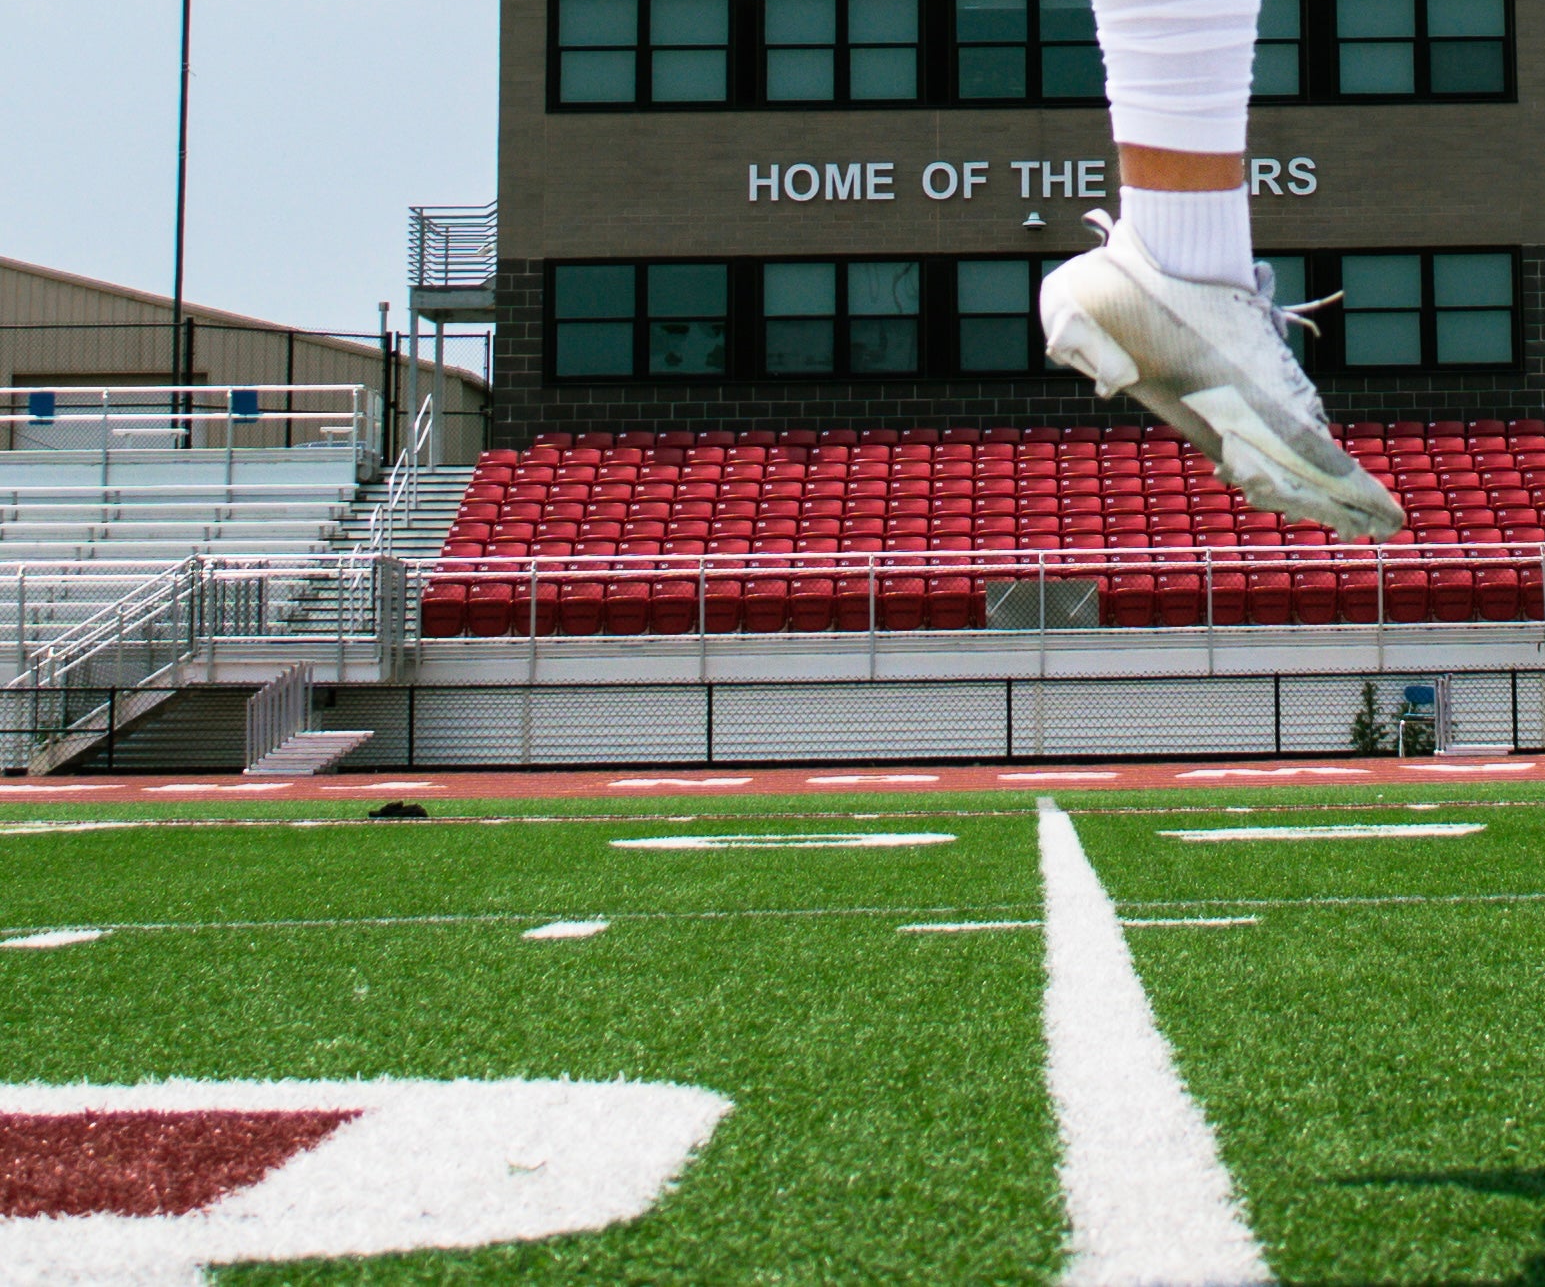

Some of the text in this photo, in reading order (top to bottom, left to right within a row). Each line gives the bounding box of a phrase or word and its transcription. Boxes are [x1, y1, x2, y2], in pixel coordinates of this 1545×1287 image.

[748, 163, 895, 202] HOME
[922, 161, 989, 200] OF
[1010, 160, 1107, 198] THE
